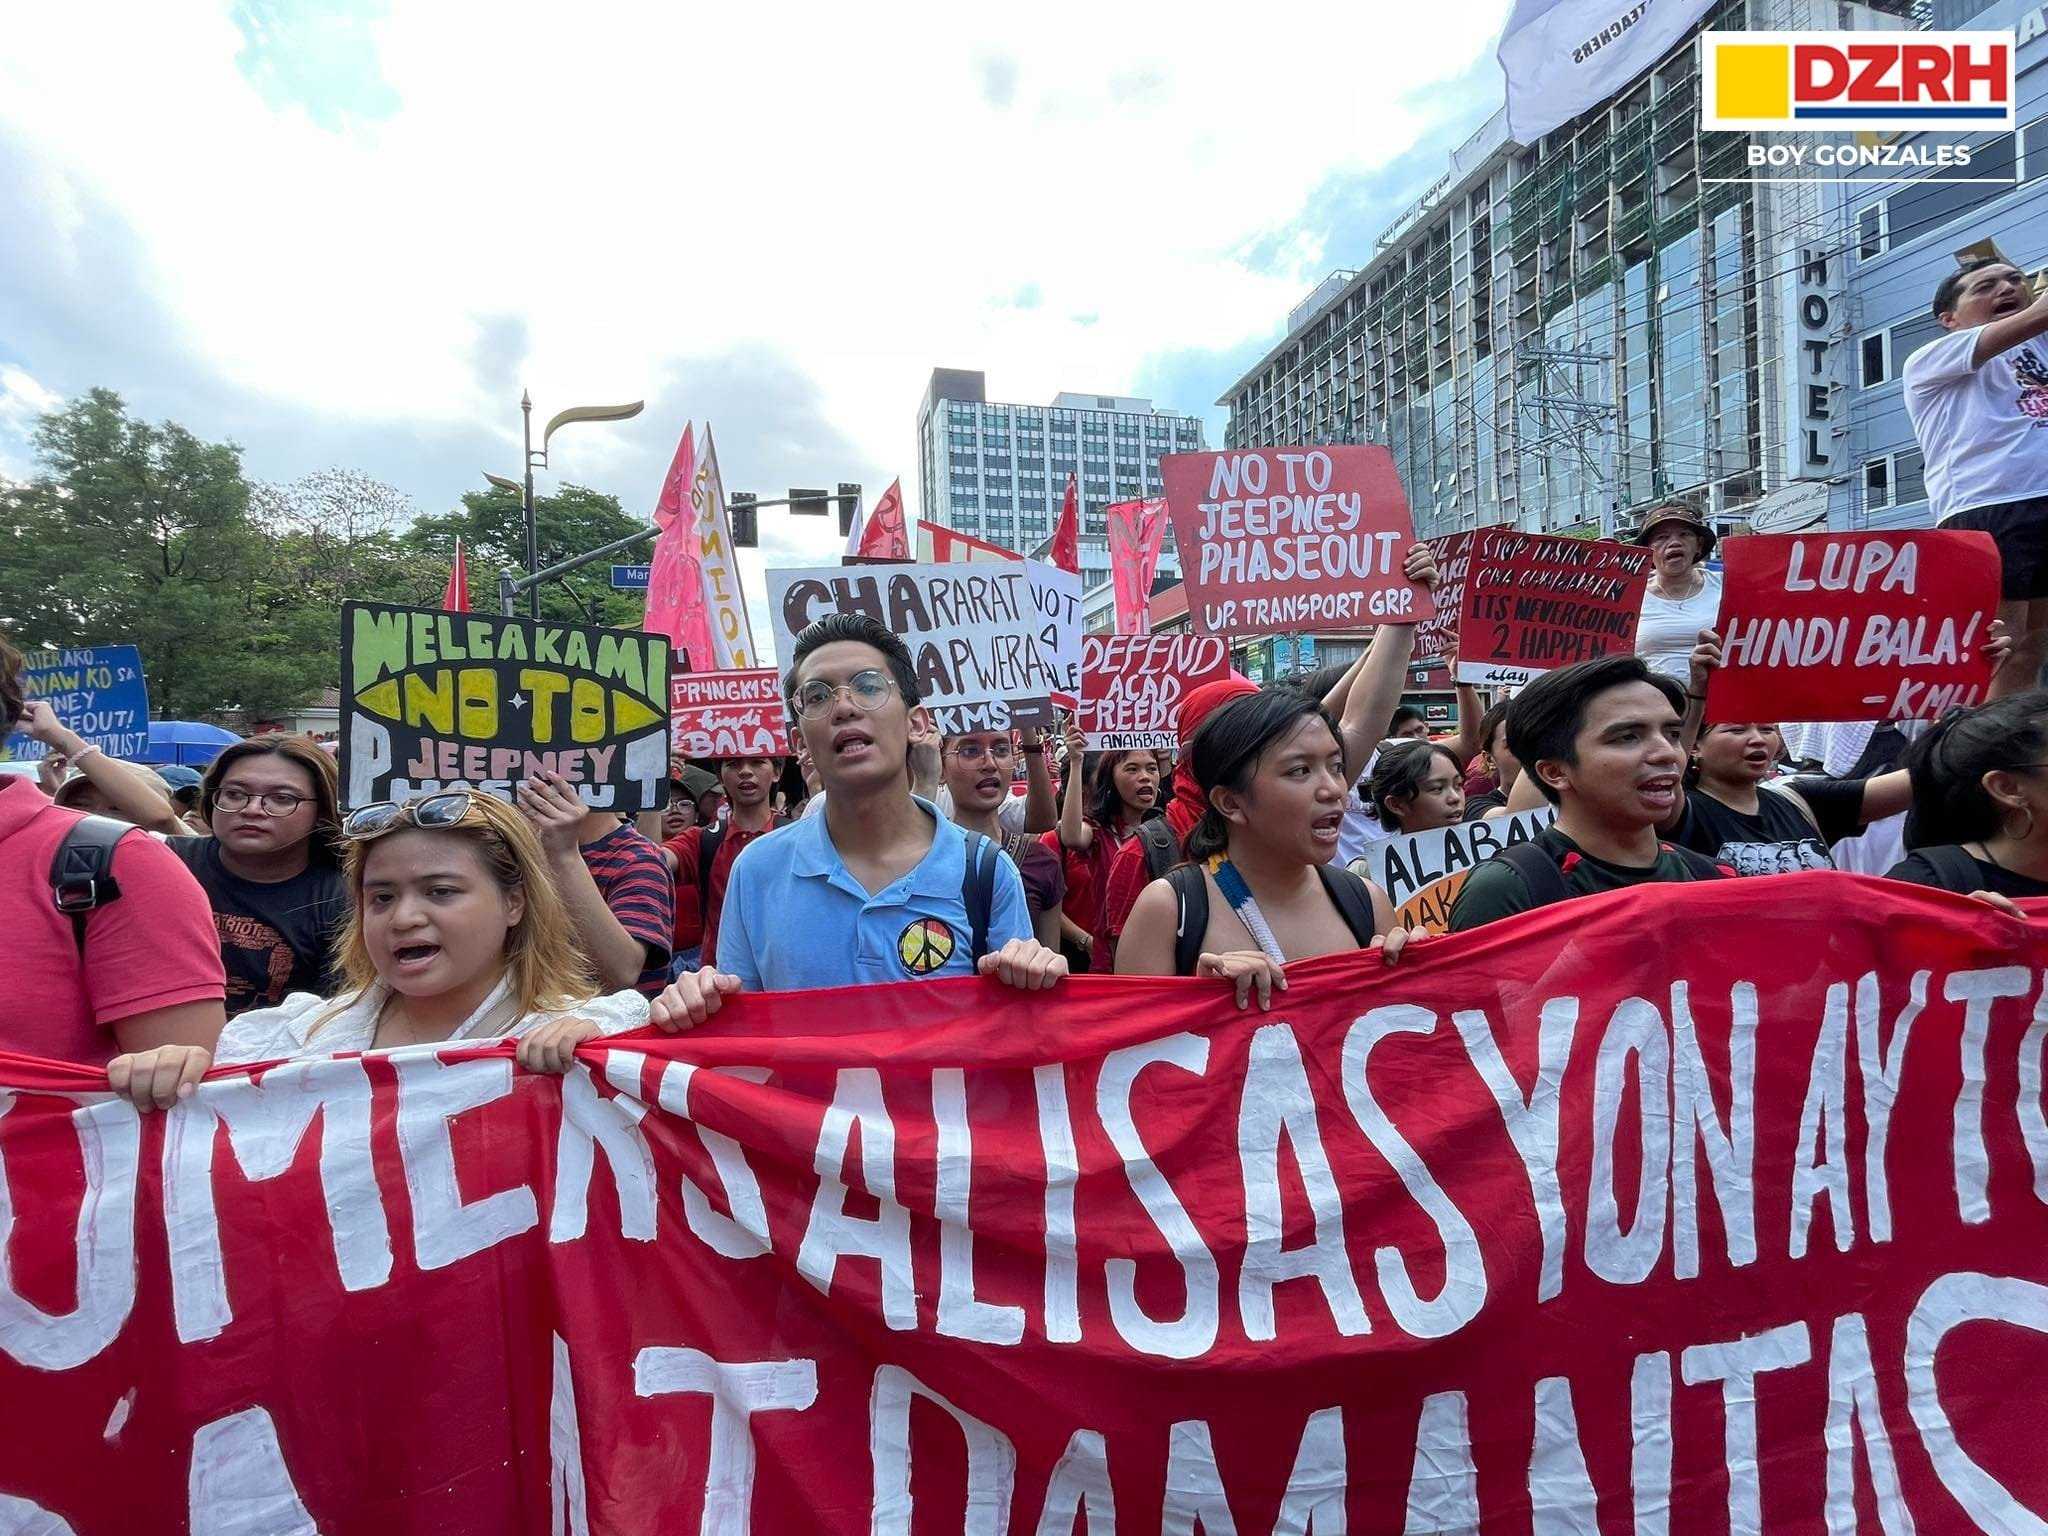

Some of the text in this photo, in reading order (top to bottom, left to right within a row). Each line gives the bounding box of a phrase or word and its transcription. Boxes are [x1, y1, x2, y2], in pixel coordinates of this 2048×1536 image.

[1802, 249, 1829, 466] HOTEL
[1209, 451, 1333, 499] NO TO
[1198, 492, 1362, 541] JEEPNEY
[1200, 531, 1402, 586] PHASEOUT
[1784, 540, 1918, 595] LUPA
[783, 573, 1023, 637] CHARARAT
[1242, 590, 1364, 626] TRANSPORT
[1368, 587, 1413, 617] GRP.
[352, 608, 668, 713] WELGA KAMI
[1082, 634, 1224, 677] DEFEND
[1490, 623, 1512, 659] 2
[1719, 610, 1983, 668] HINDI BALA!
[86, 667, 112, 688] KO
[916, 632, 1048, 698] APWERA
[404, 667, 606, 743] NO TO
[1105, 674, 1181, 706] ACAD
[83, 732, 147, 757] RTYLIST
[407, 737, 617, 784] JEEPNEY
[681, 727, 776, 758] BALA
